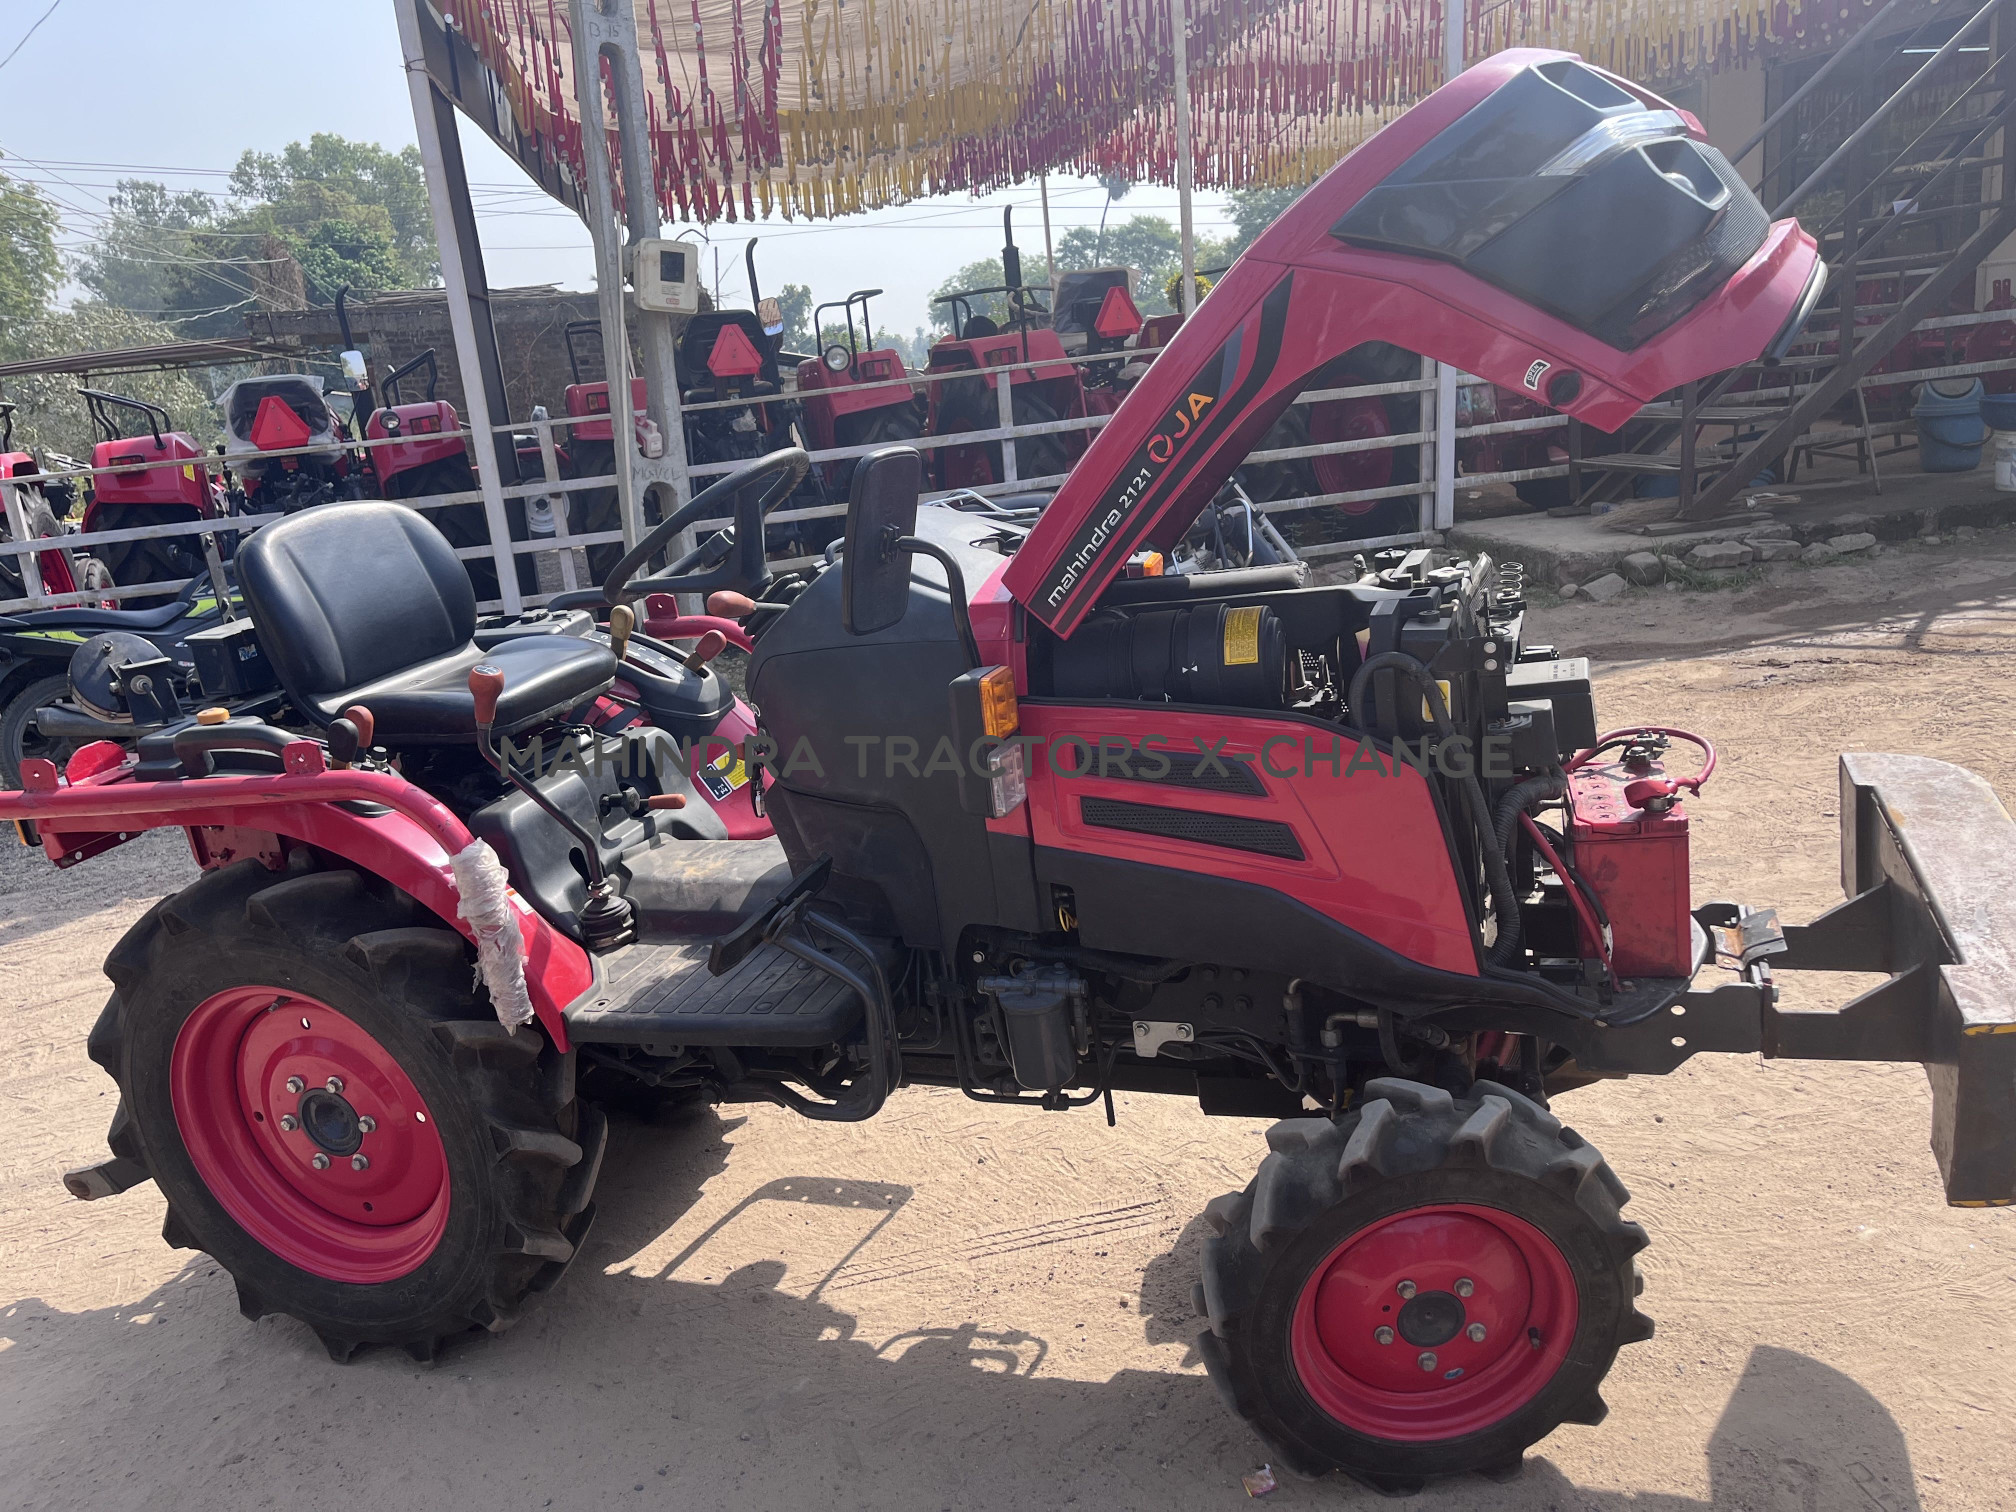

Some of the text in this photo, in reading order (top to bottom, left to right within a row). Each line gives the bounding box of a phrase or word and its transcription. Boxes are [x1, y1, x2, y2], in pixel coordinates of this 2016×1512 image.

[1527, 364, 1539, 380] OPEN
[1047, 392, 1214, 608] mahindra 2121 OJA
